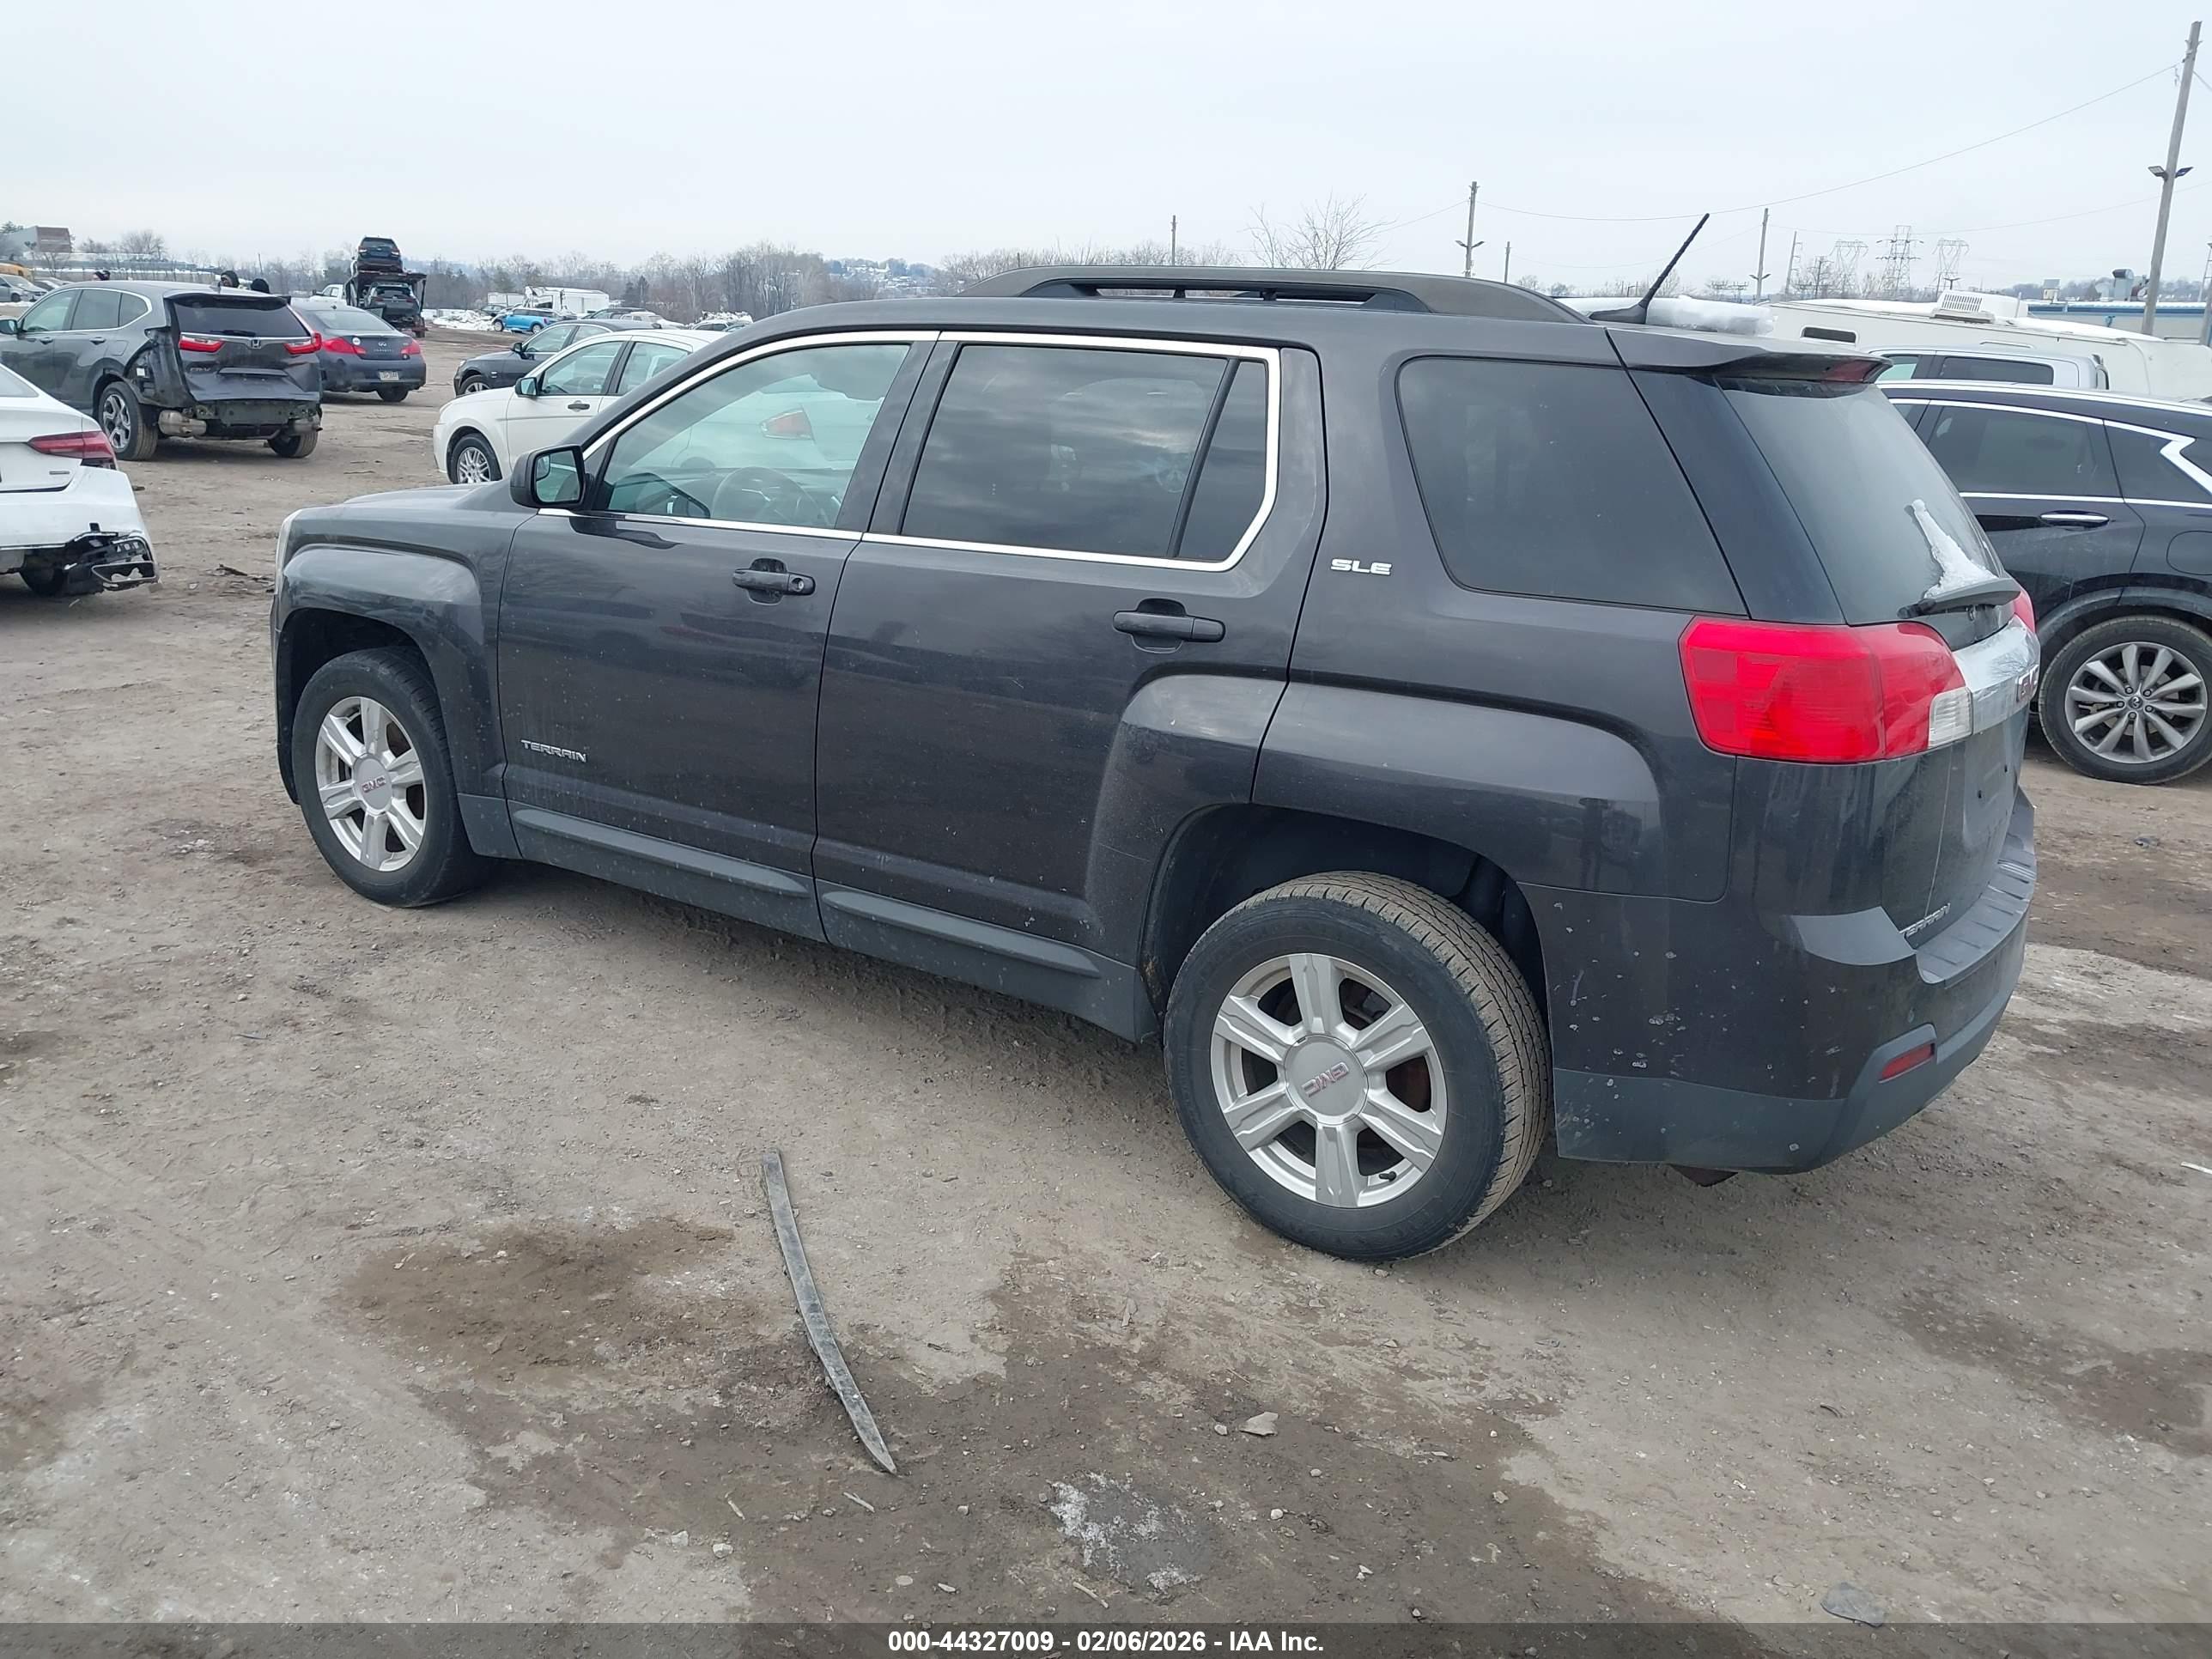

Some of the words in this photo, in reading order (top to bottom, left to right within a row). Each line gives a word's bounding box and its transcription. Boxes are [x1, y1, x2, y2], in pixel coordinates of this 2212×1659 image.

[1330, 558, 1393, 576] SLE
[520, 739, 586, 763] TERRAIN
[362, 775, 386, 793] GMC
[1301, 1061, 1349, 1097] GMC
